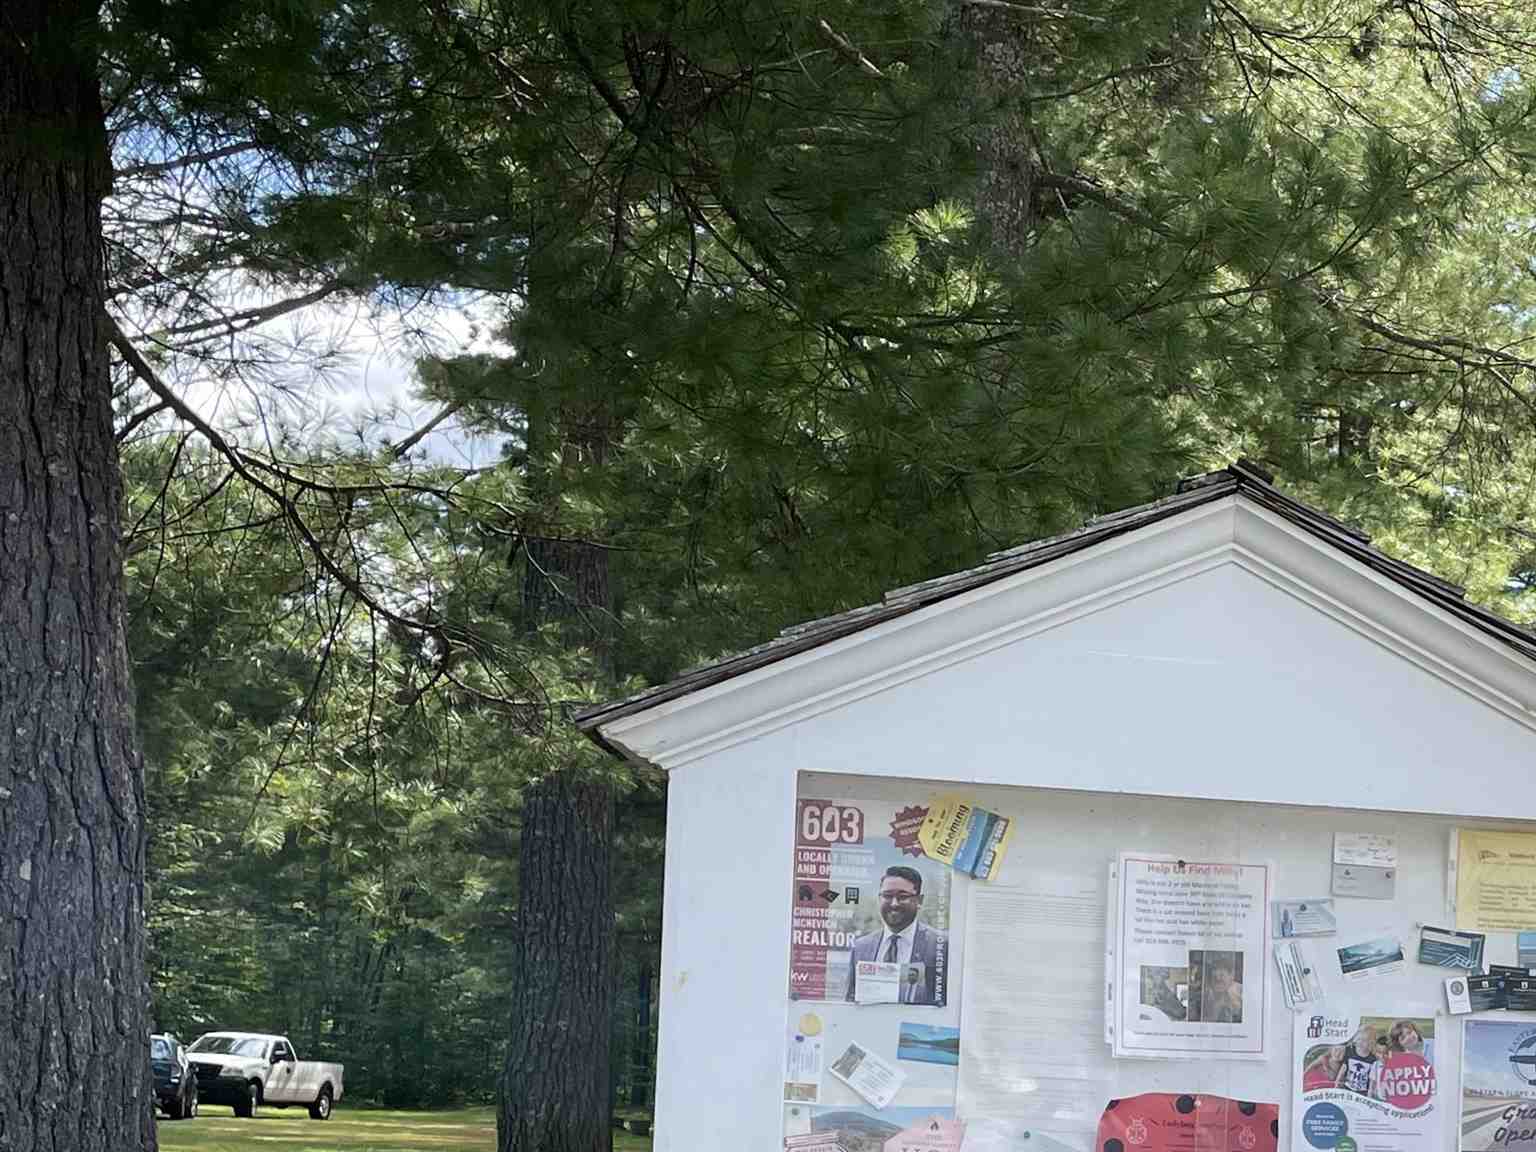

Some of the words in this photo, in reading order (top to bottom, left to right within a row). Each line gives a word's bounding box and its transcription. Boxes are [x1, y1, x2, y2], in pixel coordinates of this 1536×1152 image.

[802, 805, 860, 842] 603
[792, 930, 856, 948] REALTOR
[1325, 1018, 1349, 1028] Head
[1325, 1028, 1349, 1038] Start
[1384, 1065, 1431, 1081] APPLY
[1380, 1079, 1437, 1096] NOW!
